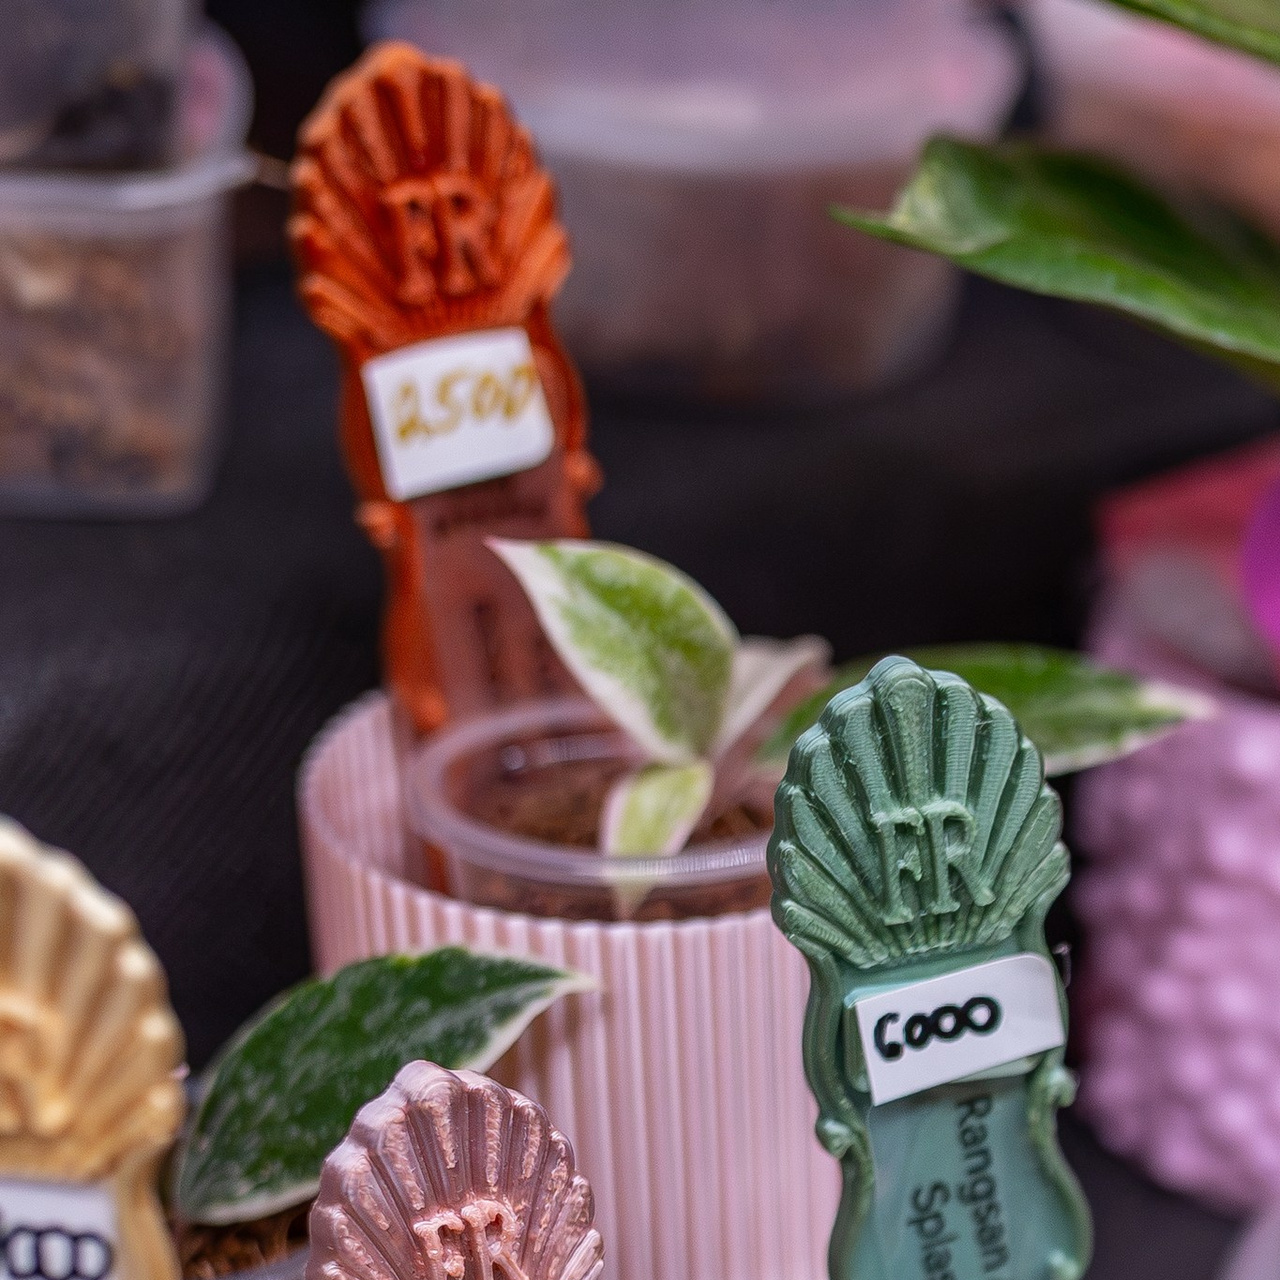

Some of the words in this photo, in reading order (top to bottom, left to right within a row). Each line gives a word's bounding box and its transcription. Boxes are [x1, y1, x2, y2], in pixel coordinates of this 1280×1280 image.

[873, 796, 997, 926] FR
[873, 996, 1001, 1061] 6000
[955, 1093, 1011, 1273] Rangsan
